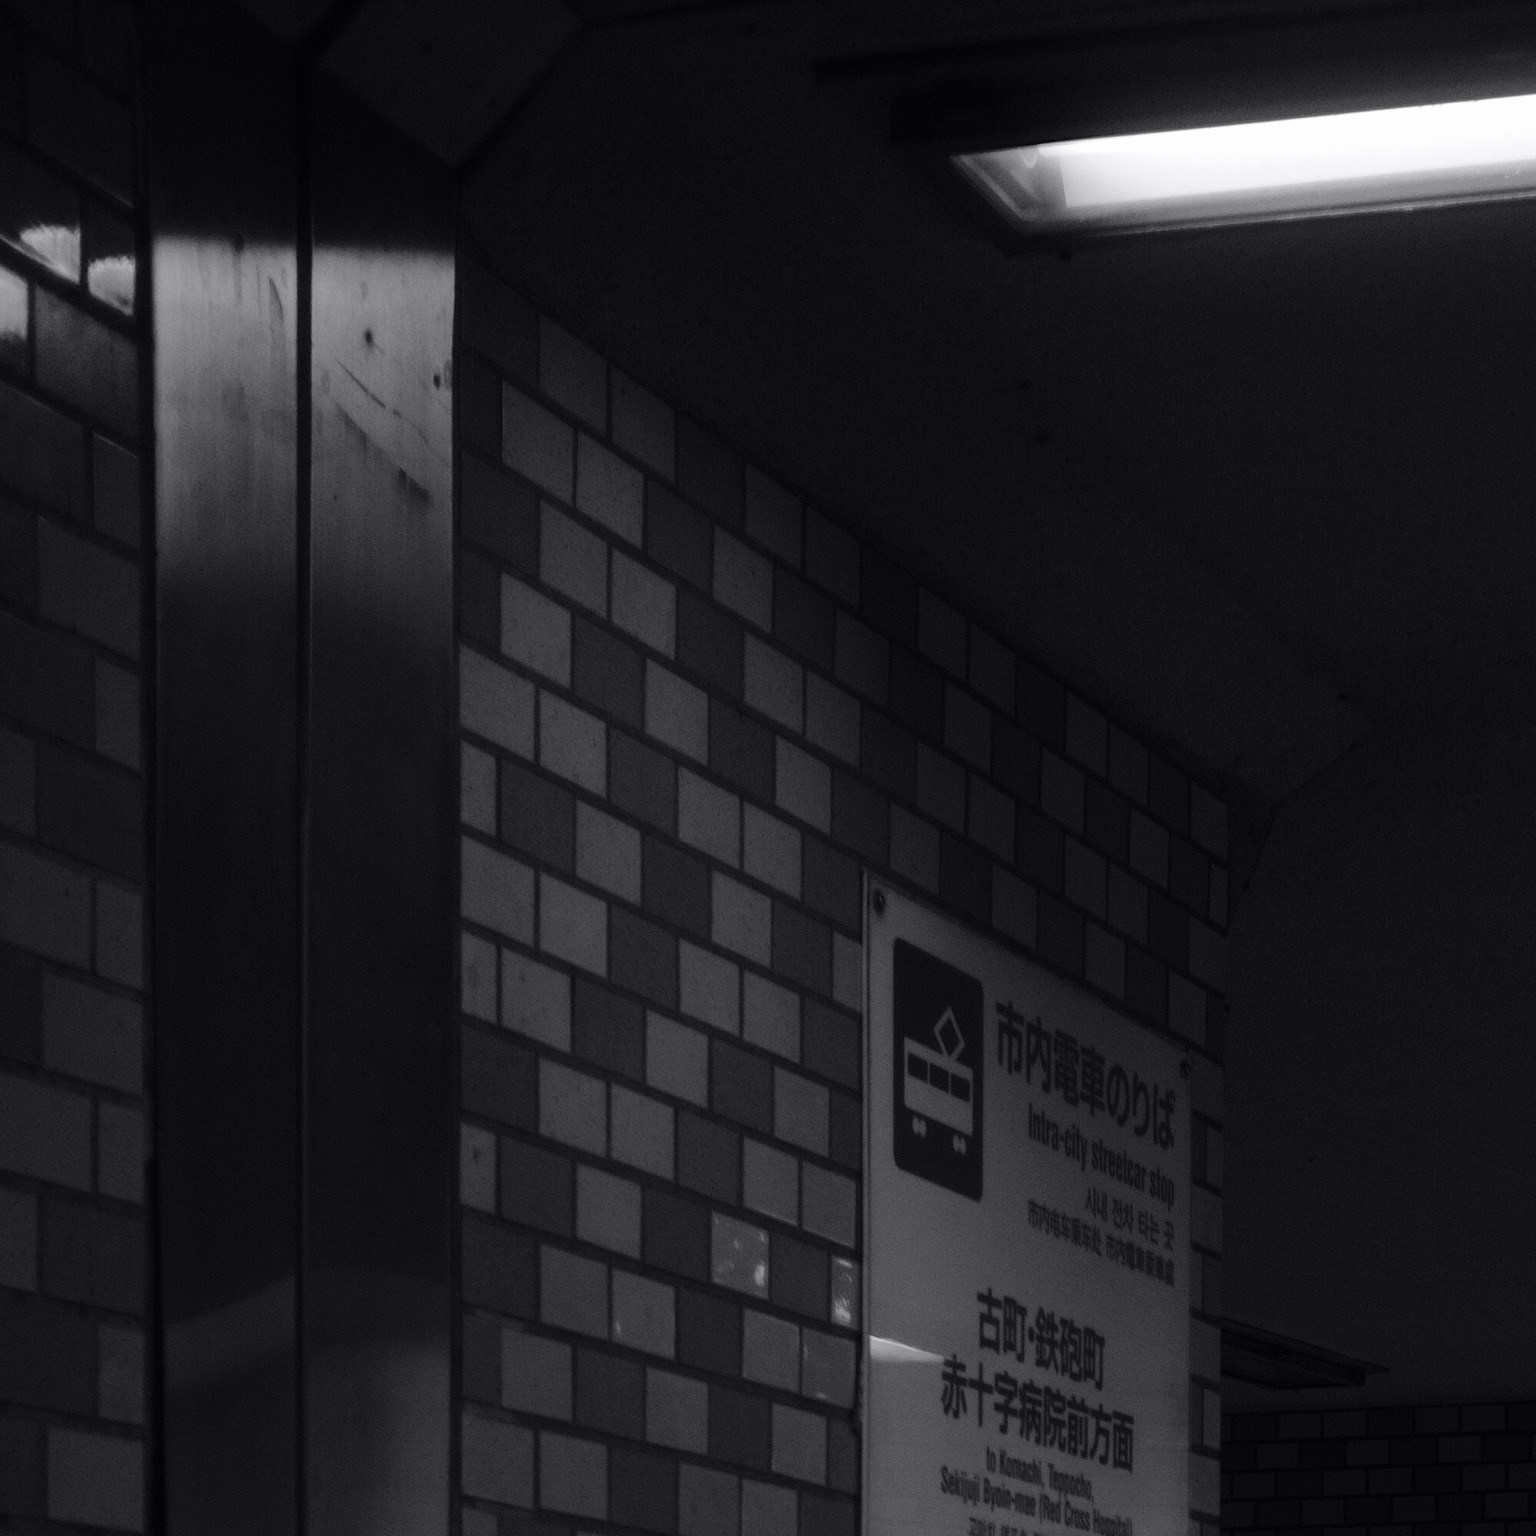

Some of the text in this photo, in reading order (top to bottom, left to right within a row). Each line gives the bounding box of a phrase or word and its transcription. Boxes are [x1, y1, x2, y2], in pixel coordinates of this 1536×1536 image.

[996, 1000, 1176, 1150] 市内電車のりば
[1027, 1102, 1175, 1212] Intra-city streetcar stop
[1084, 1187, 1174, 1252] 시내 전차 타는 곳
[940, 1352, 1134, 1473] 赤十字病院前方面
[940, 1465, 979, 1505] Sekijuji
[982, 1476, 1036, 1517] Byoin-mae
[1038, 1493, 1061, 1524] (Red
[1063, 1498, 1090, 1532] Cross
[985, 1445, 996, 1473] to
[998, 1448, 1044, 1488] Komachi,
